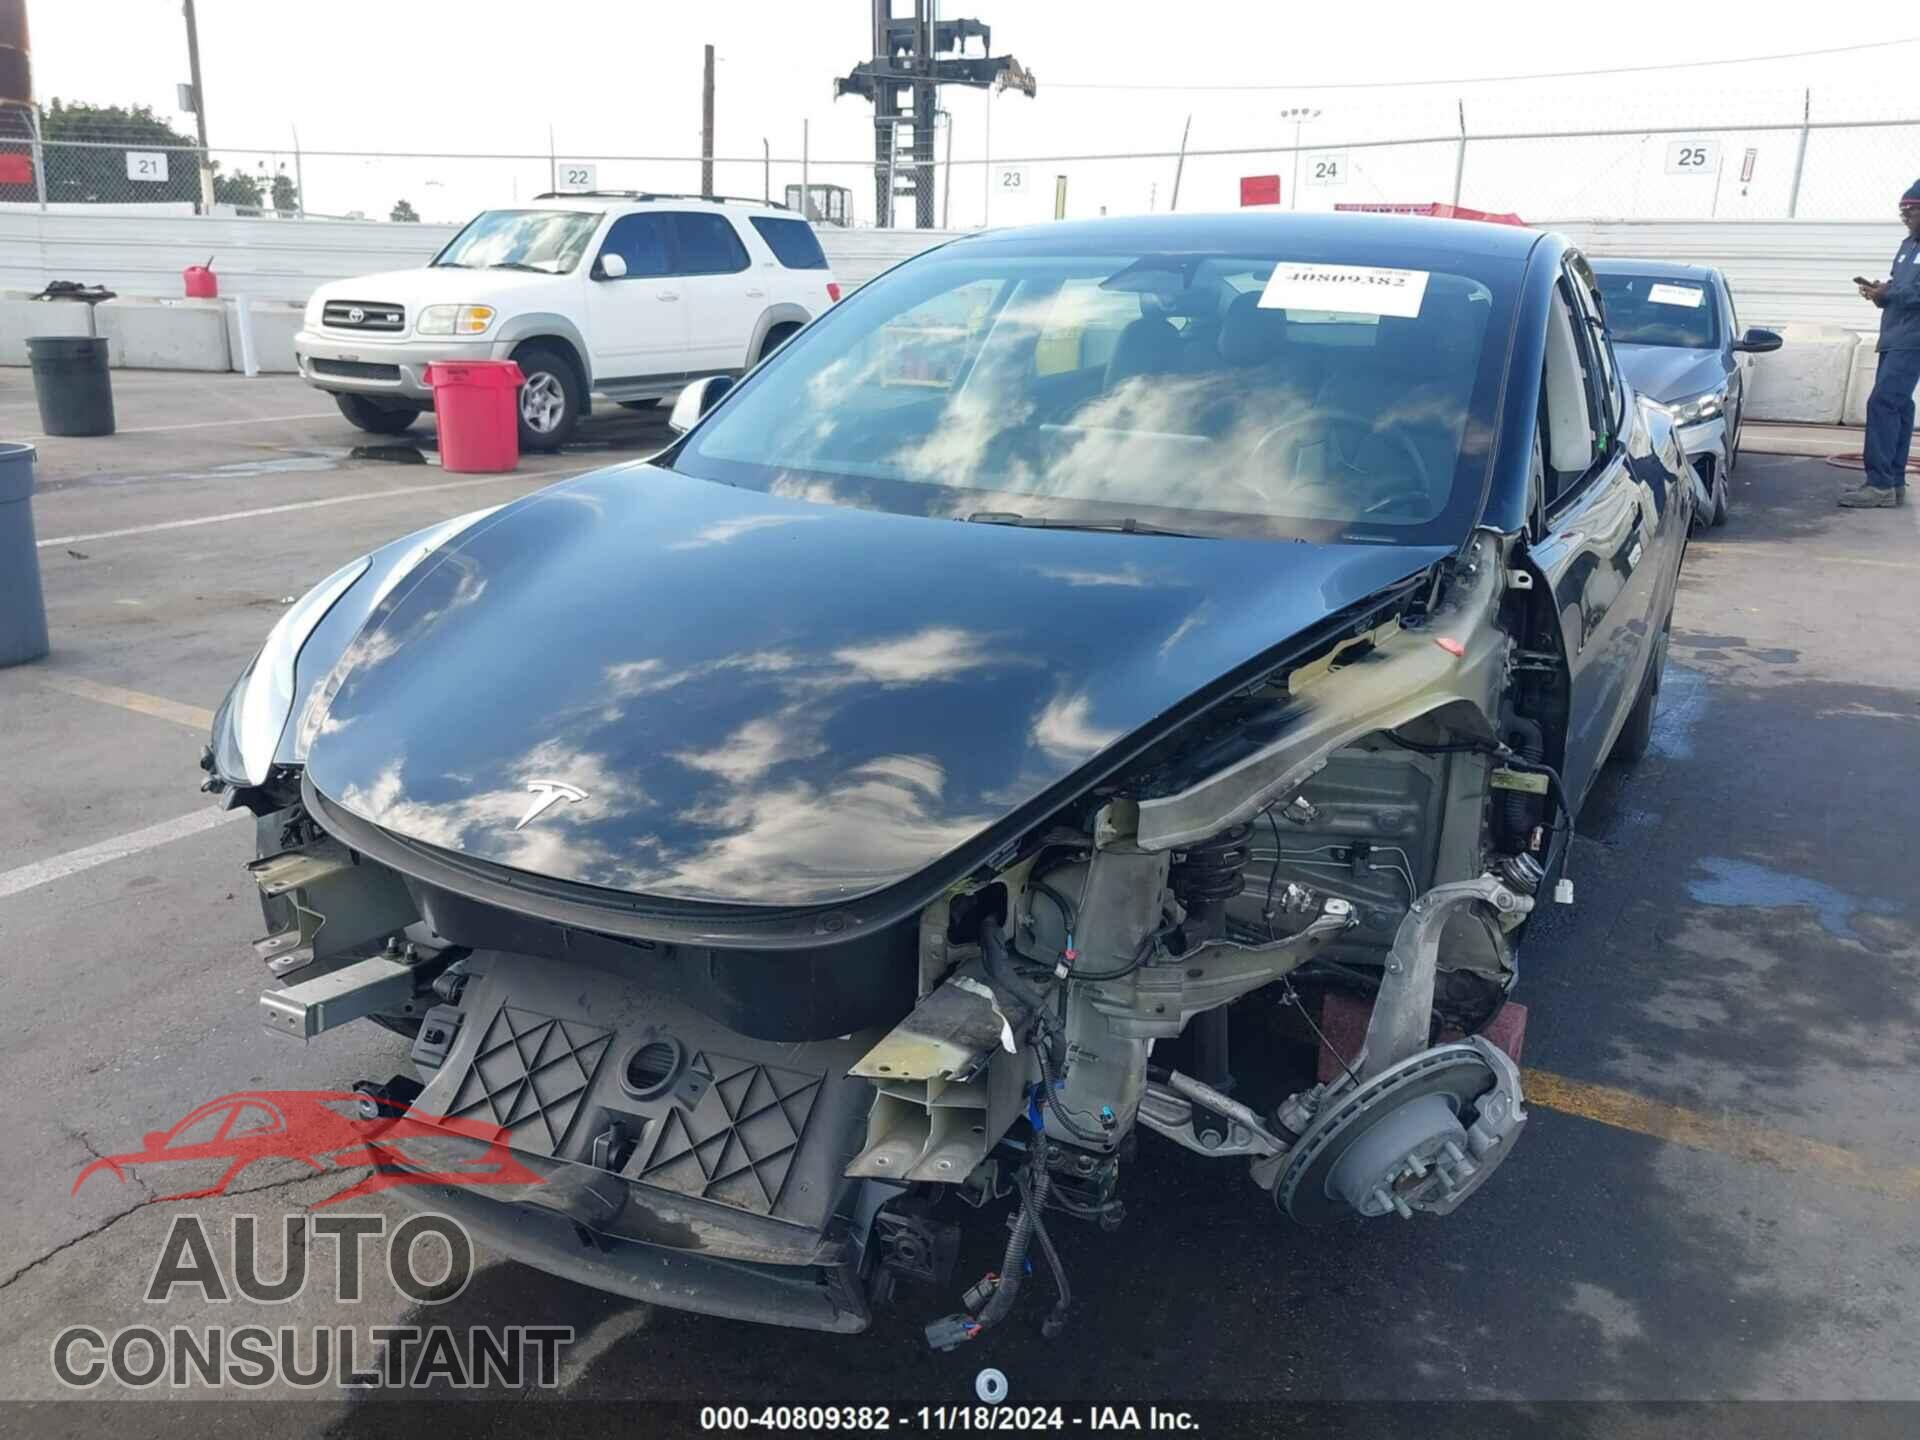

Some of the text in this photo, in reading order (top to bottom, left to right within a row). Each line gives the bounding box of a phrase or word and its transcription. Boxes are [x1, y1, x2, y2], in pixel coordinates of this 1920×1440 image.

[1678, 148, 1707, 166] 25
[139, 159, 157, 174] 21
[1315, 162, 1337, 178] 24
[568, 169, 588, 185] 22
[1003, 171, 1021, 187] 23
